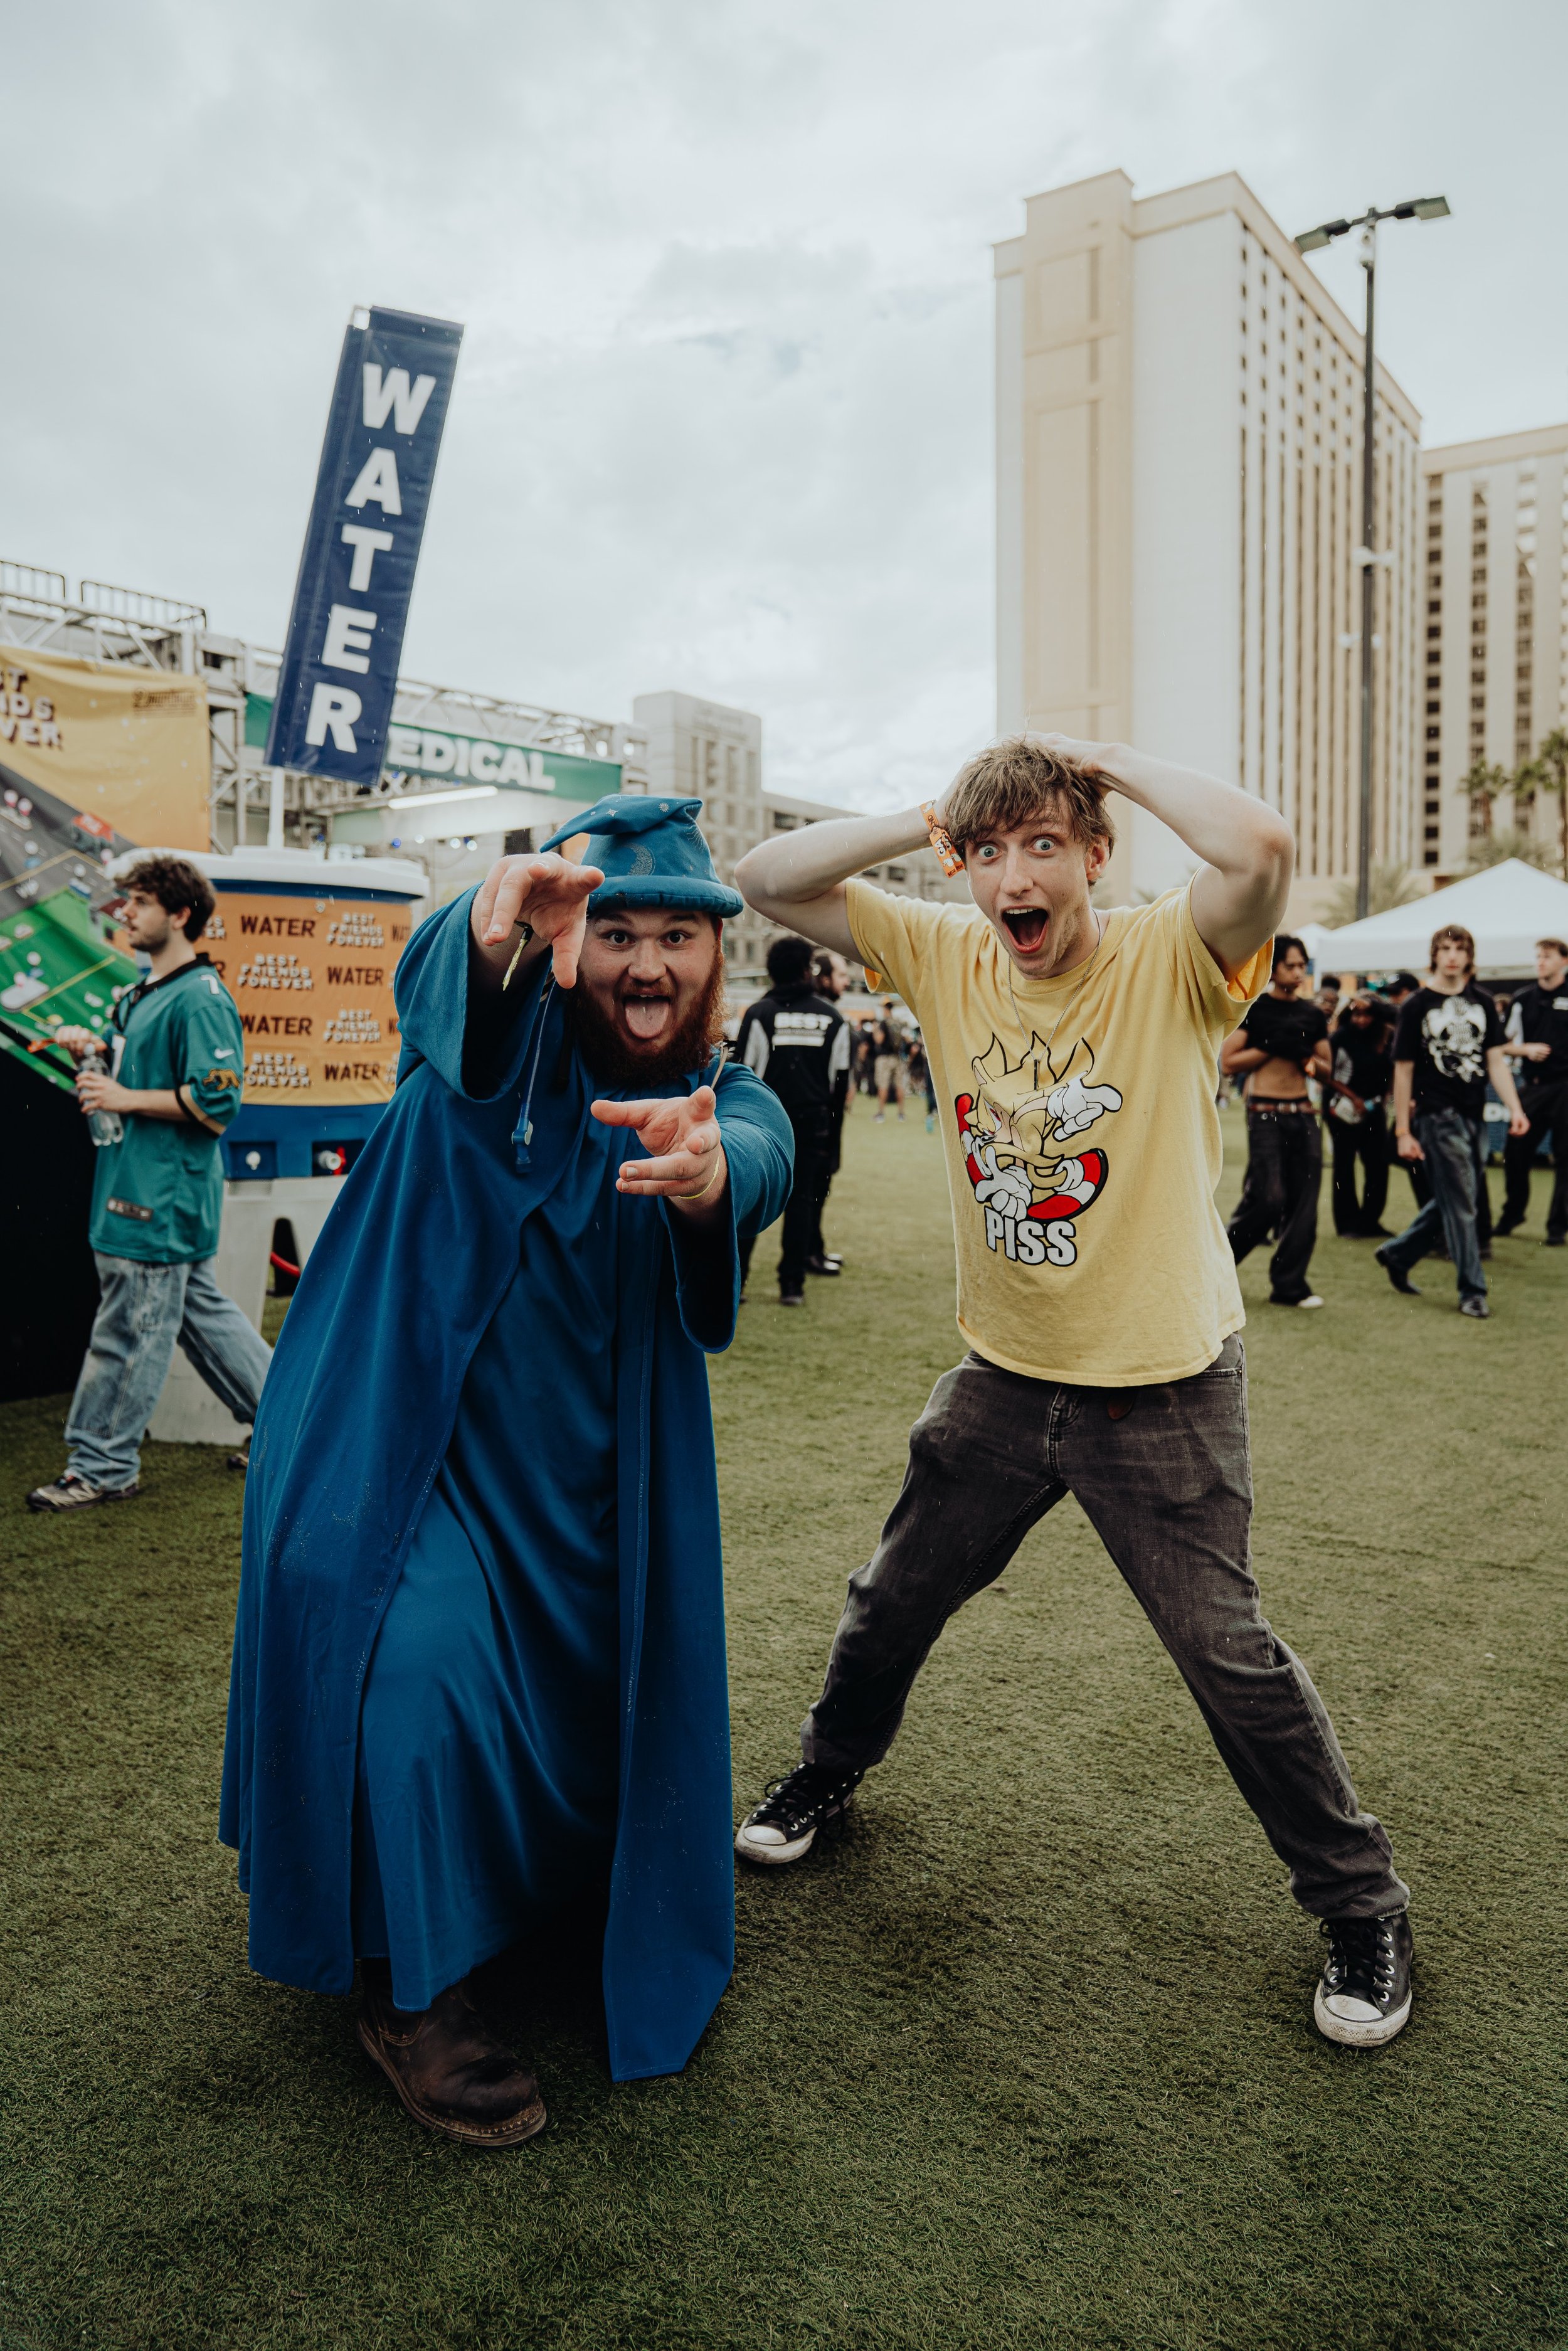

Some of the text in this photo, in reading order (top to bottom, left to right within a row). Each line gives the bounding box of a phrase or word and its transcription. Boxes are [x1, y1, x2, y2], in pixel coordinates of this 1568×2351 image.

[305, 362, 437, 753] WATER
[387, 726, 556, 791] EDICAL
[241, 915, 316, 937] WATER
[342, 913, 374, 925] BEST
[255, 953, 298, 965] BEST
[241, 963, 310, 978] FRIENDS
[327, 966, 383, 985] WATER
[237, 975, 313, 990] FOREVER
[339, 1009, 371, 1021] BEST
[774, 1012, 833, 1031] BEST
[240, 1014, 312, 1035] WATER
[253, 1052, 295, 1064] BEST
[244, 1064, 309, 1077] RIENDS
[325, 1063, 380, 1081] WATER
[245, 1074, 311, 1088] OREVER
[985, 1206, 1077, 1266] PISS
